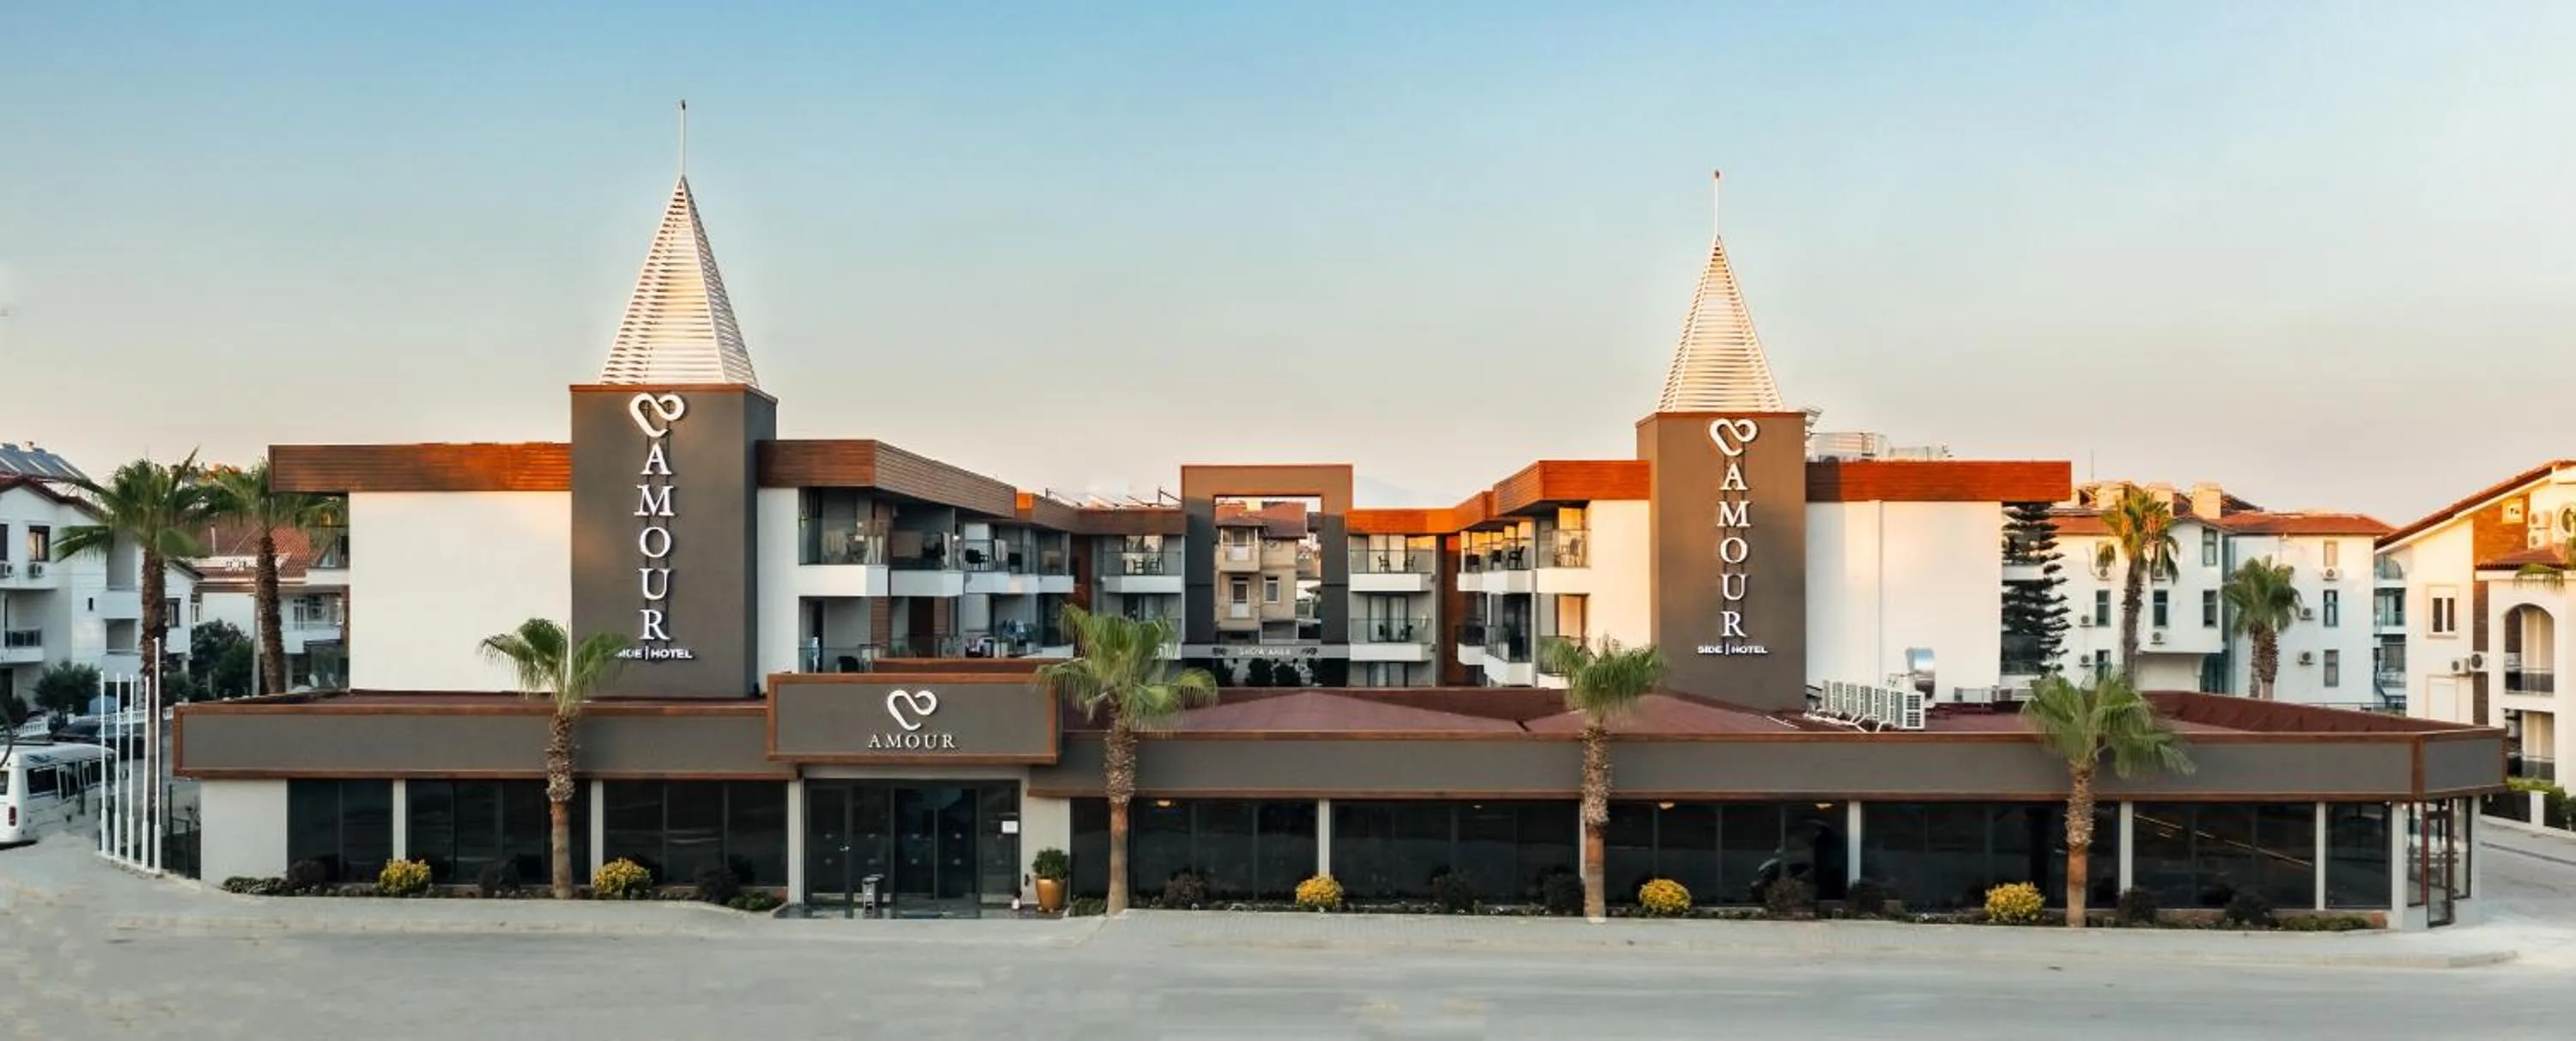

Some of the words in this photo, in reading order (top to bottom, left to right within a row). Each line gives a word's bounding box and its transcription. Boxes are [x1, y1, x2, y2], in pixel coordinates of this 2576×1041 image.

[634, 442, 676, 640] AMOUR
[1716, 462, 1752, 638] AMOUR
[651, 648, 693, 659] HOTEL
[868, 734, 956, 749] AMOUR
